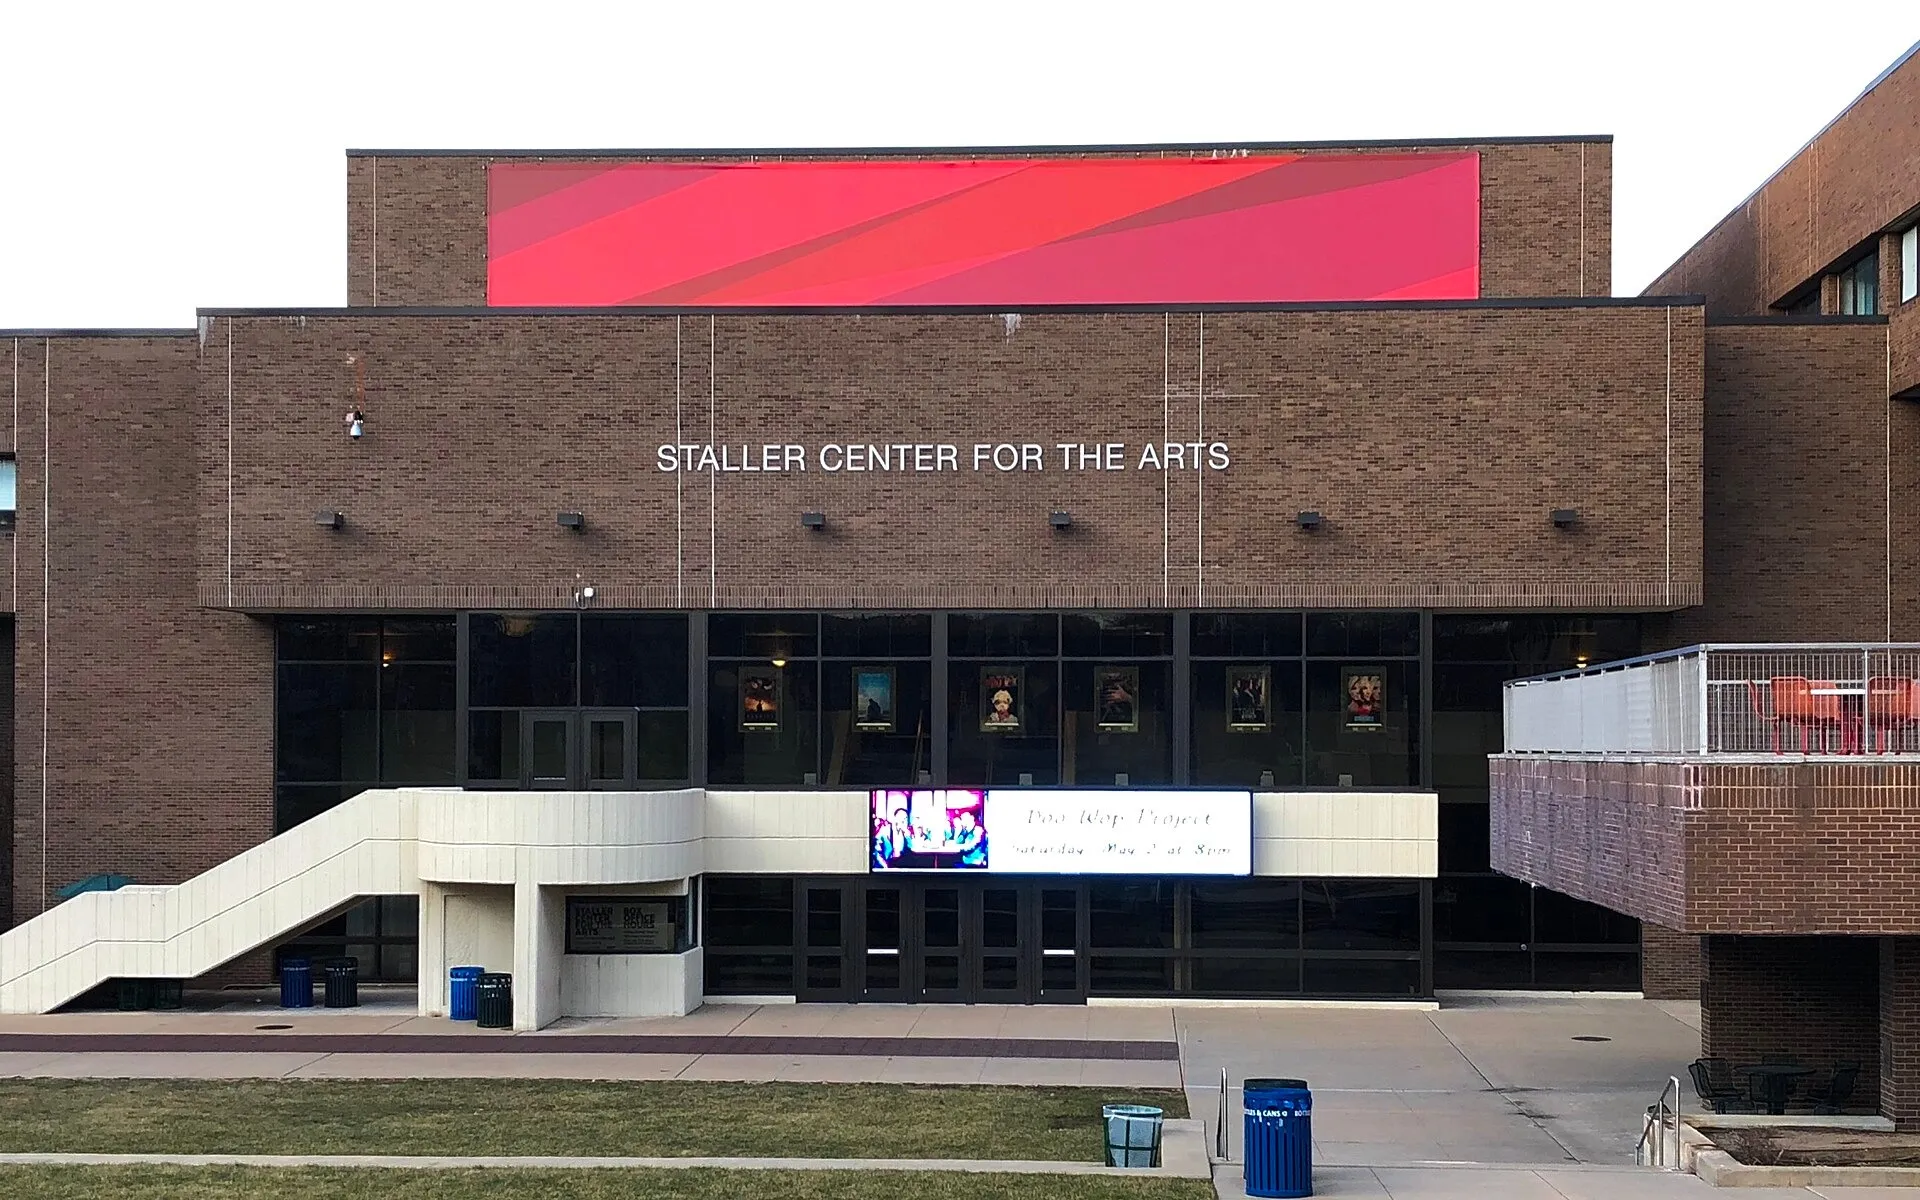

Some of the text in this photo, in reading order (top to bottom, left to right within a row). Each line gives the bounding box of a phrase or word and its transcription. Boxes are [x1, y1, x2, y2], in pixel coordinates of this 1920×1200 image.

[656, 442, 1231, 472] STALLER CENTER FOR THE ARTS
[1138, 808, 1213, 829] Project
